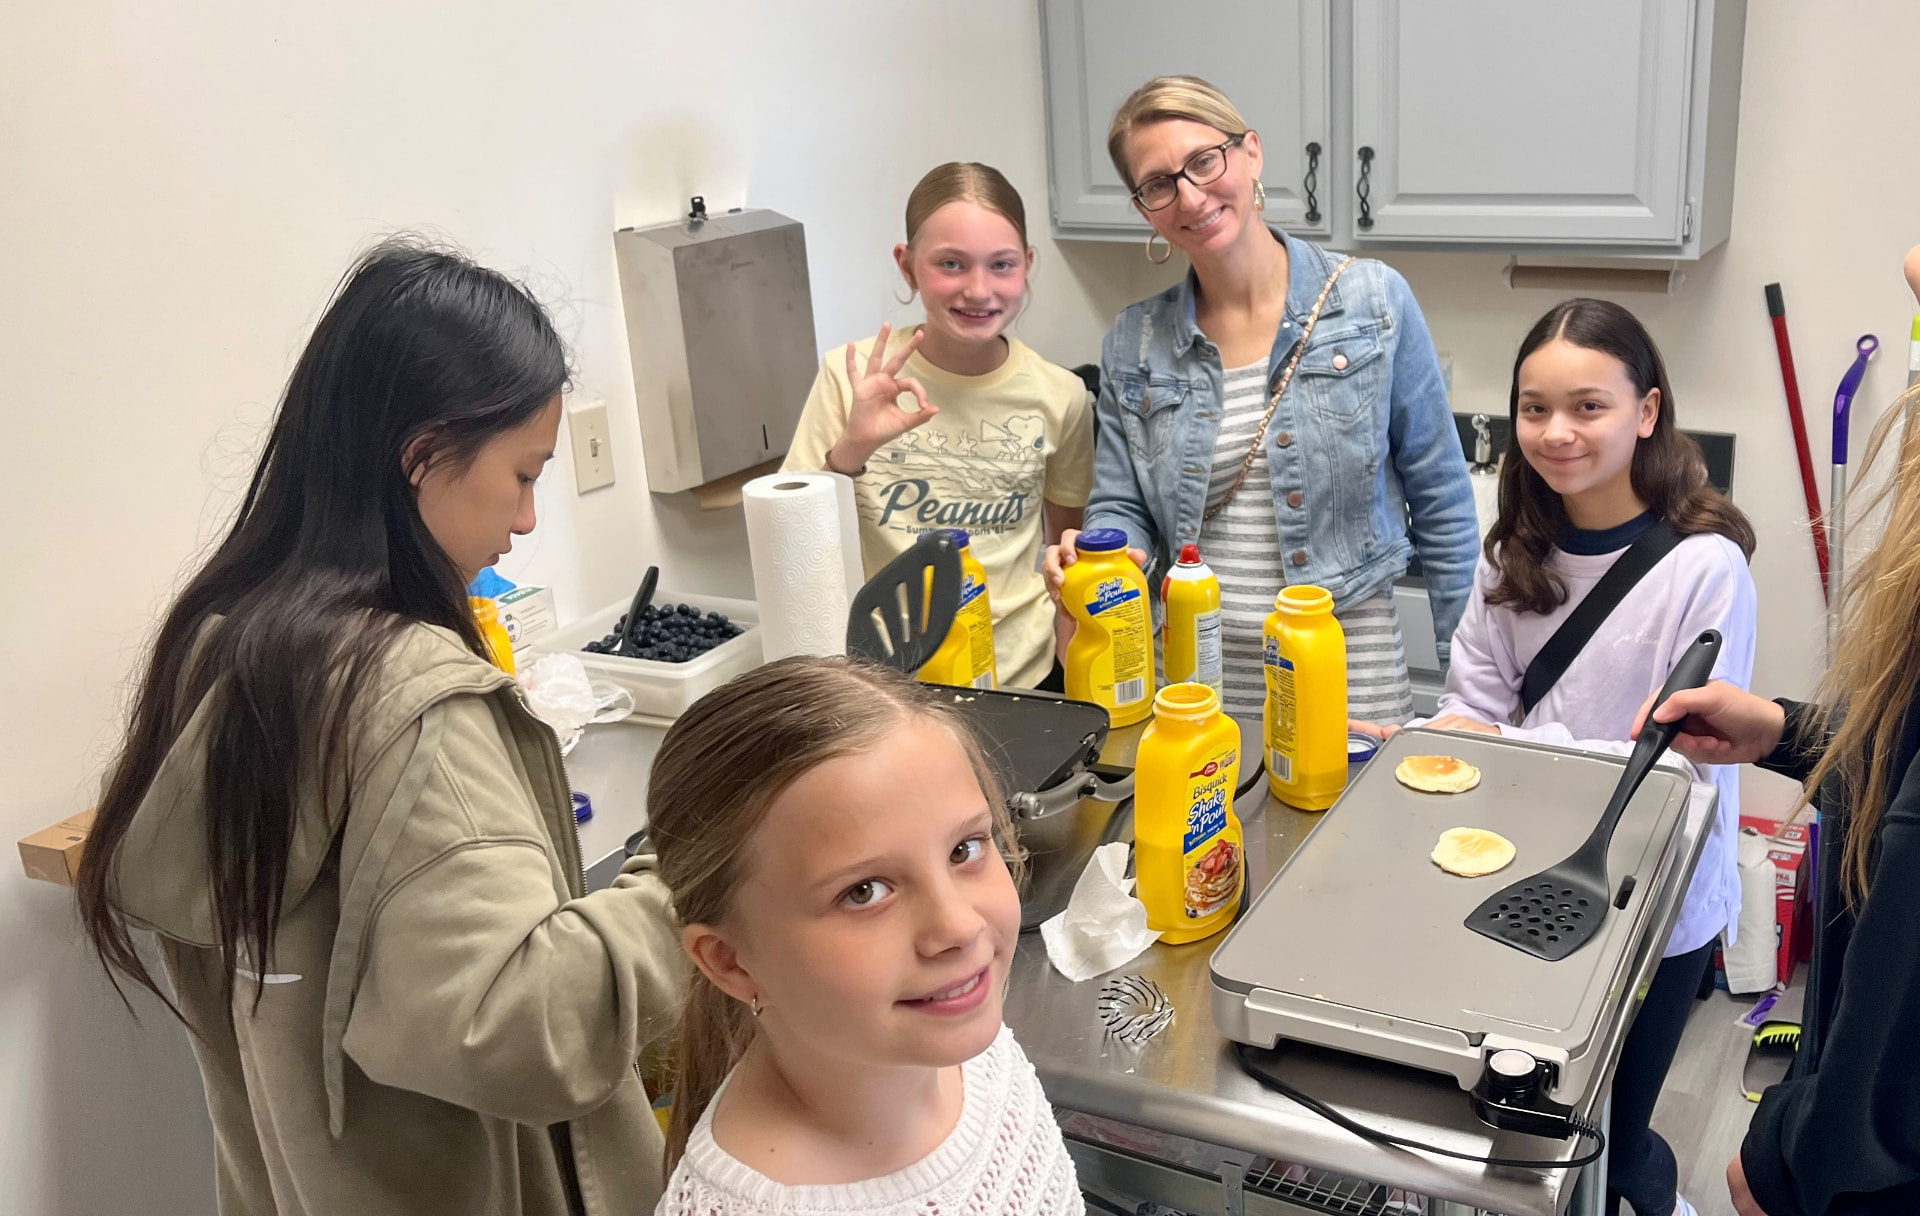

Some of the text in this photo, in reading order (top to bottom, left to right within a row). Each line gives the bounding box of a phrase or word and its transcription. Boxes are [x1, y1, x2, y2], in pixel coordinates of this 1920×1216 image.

[878, 478, 1030, 527] Peanuts
[1096, 578, 1122, 597] Shake
[1104, 588, 1123, 602] Pour
[1193, 773, 1227, 799] Bisquick
[1187, 788, 1226, 825] Shake
[1199, 801, 1227, 834] Pour
